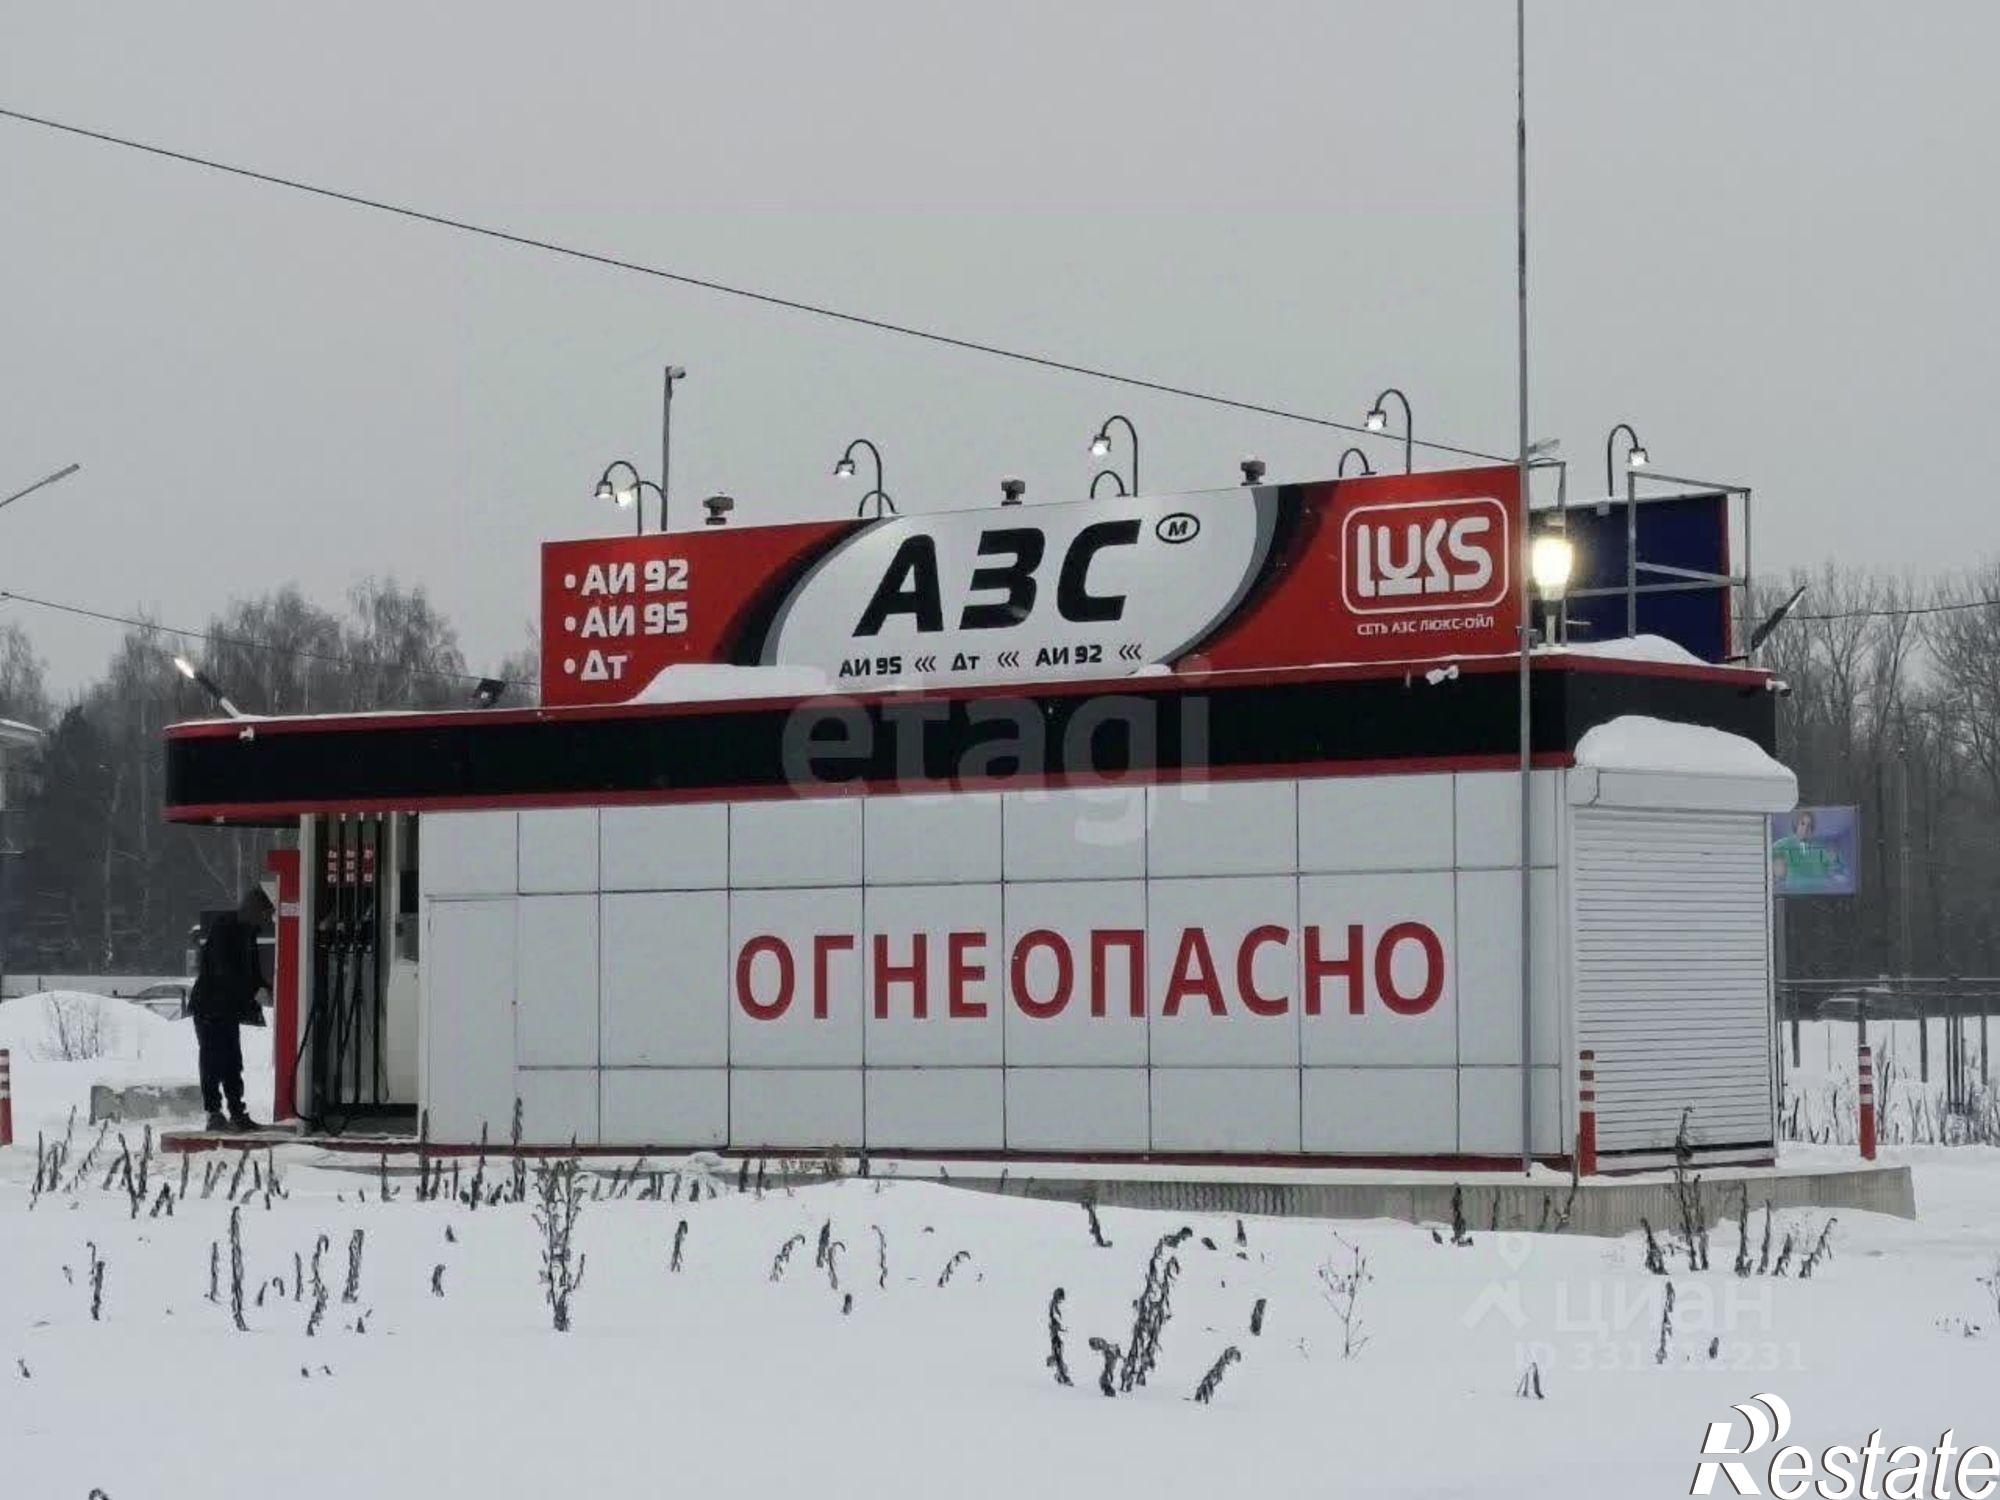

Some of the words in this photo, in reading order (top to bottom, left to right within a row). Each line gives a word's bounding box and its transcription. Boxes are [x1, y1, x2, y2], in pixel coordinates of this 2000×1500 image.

[1357, 516, 1493, 597] LUKS
[580, 562, 635, 596] АИ
[644, 558, 688, 592] 92
[852, 518, 1142, 637] АЗС
[580, 604, 635, 638] АИ
[643, 601, 688, 635] 95
[1357, 622, 1389, 635] СЕТЬ
[1391, 620, 1418, 633] АЗС
[1420, 613, 1494, 631] ЛЮКС-ОЙЛ
[839, 658, 871, 678] АИ
[876, 655, 902, 675] 95
[1035, 647, 1069, 667] АИ
[1074, 644, 1103, 664] 92
[735, 921, 1445, 1021] ОГНЕОПАСНО
